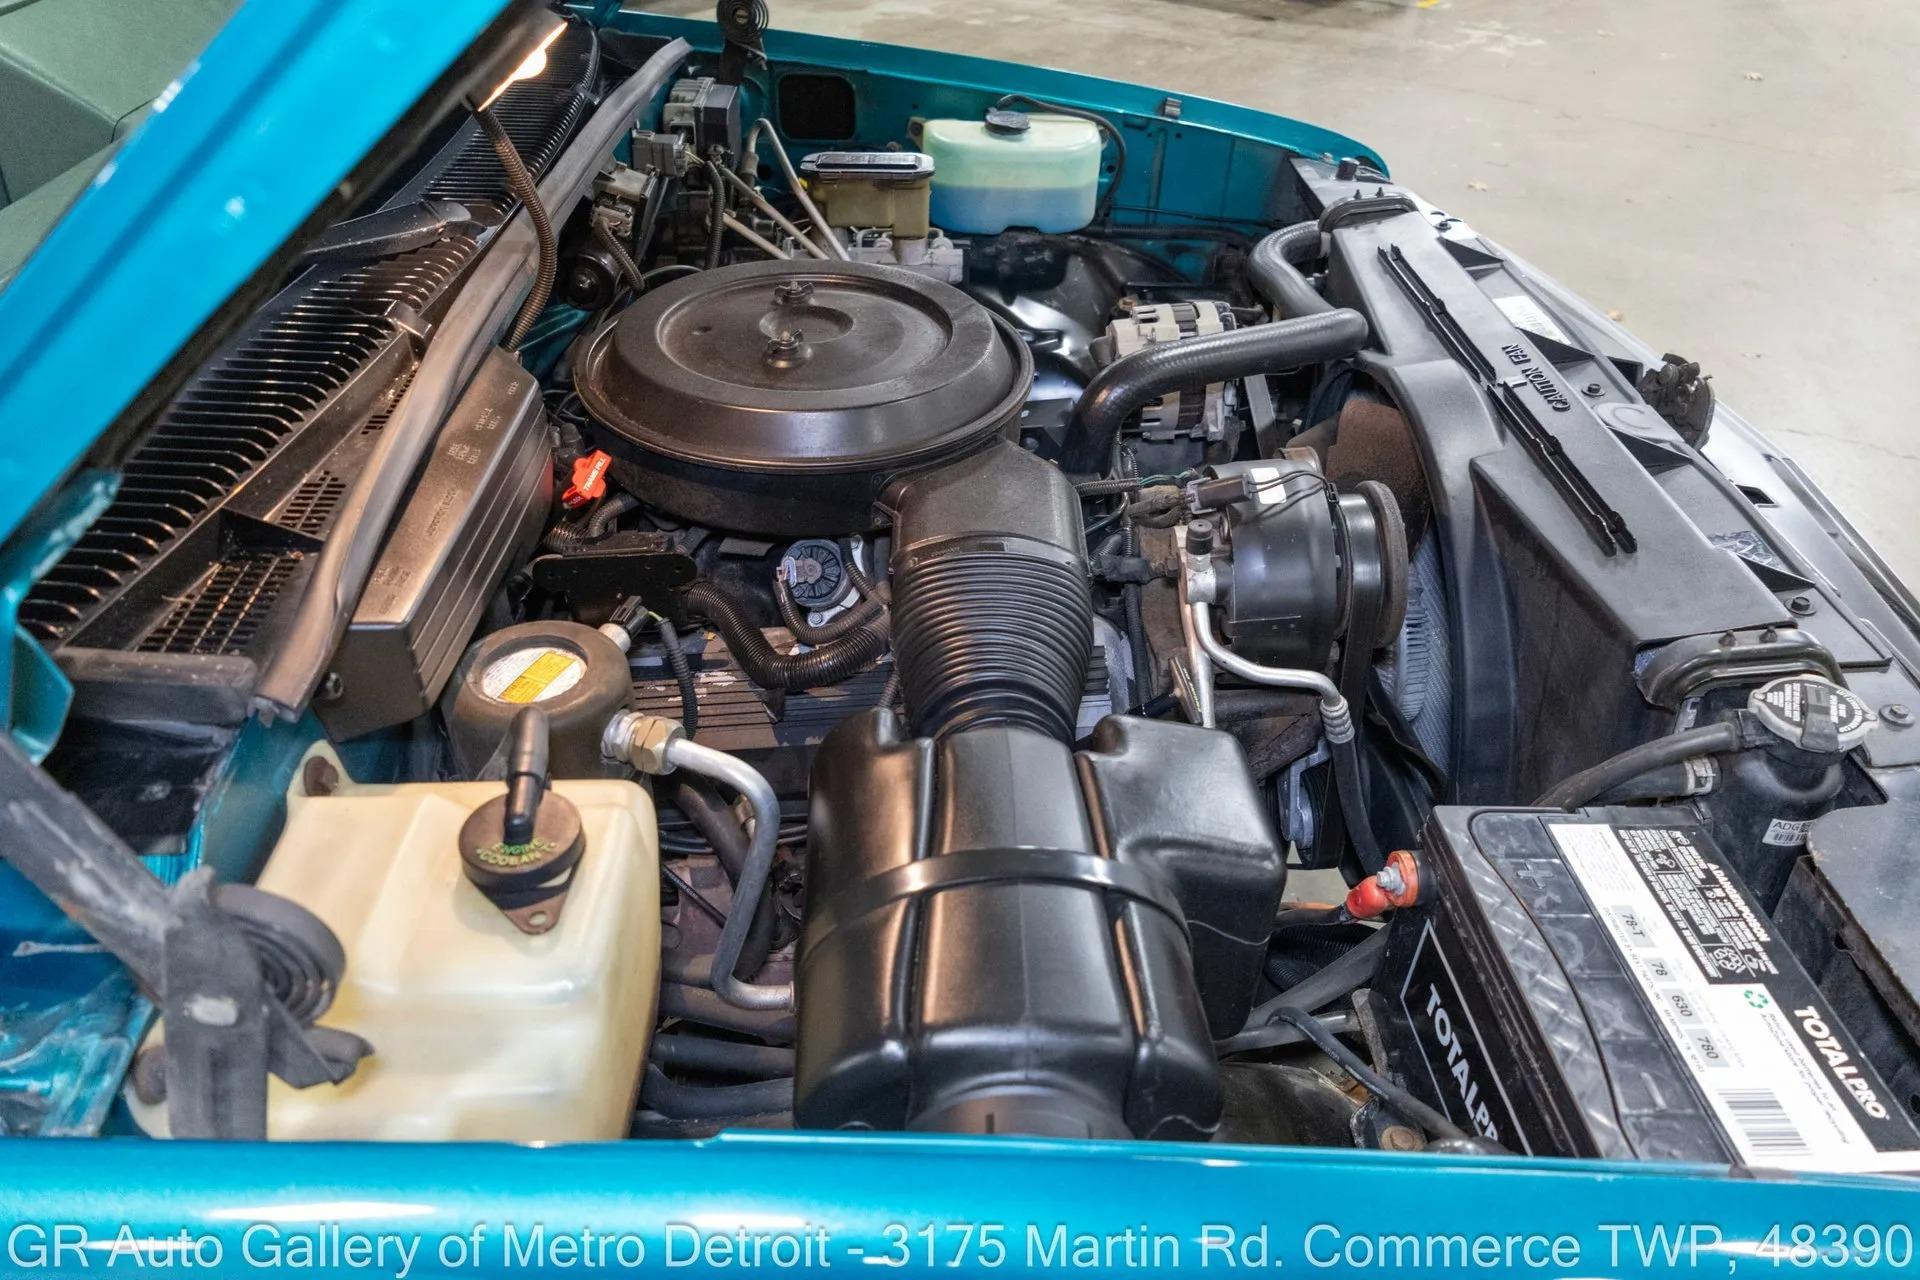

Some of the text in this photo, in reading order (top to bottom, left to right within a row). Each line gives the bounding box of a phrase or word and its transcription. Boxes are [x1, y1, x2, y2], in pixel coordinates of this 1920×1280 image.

[1501, 343, 1532, 366] FAN
[1520, 367, 1572, 412] CAUTION
[1622, 913, 1646, 938] 78-T
[1651, 961, 1668, 977] 78
[1672, 994, 1693, 1018] 630
[1697, 1036, 1719, 1060] 780
[1426, 982, 1499, 1142] TOTALPR
[1794, 1005, 1887, 1119] TOTALPRO
